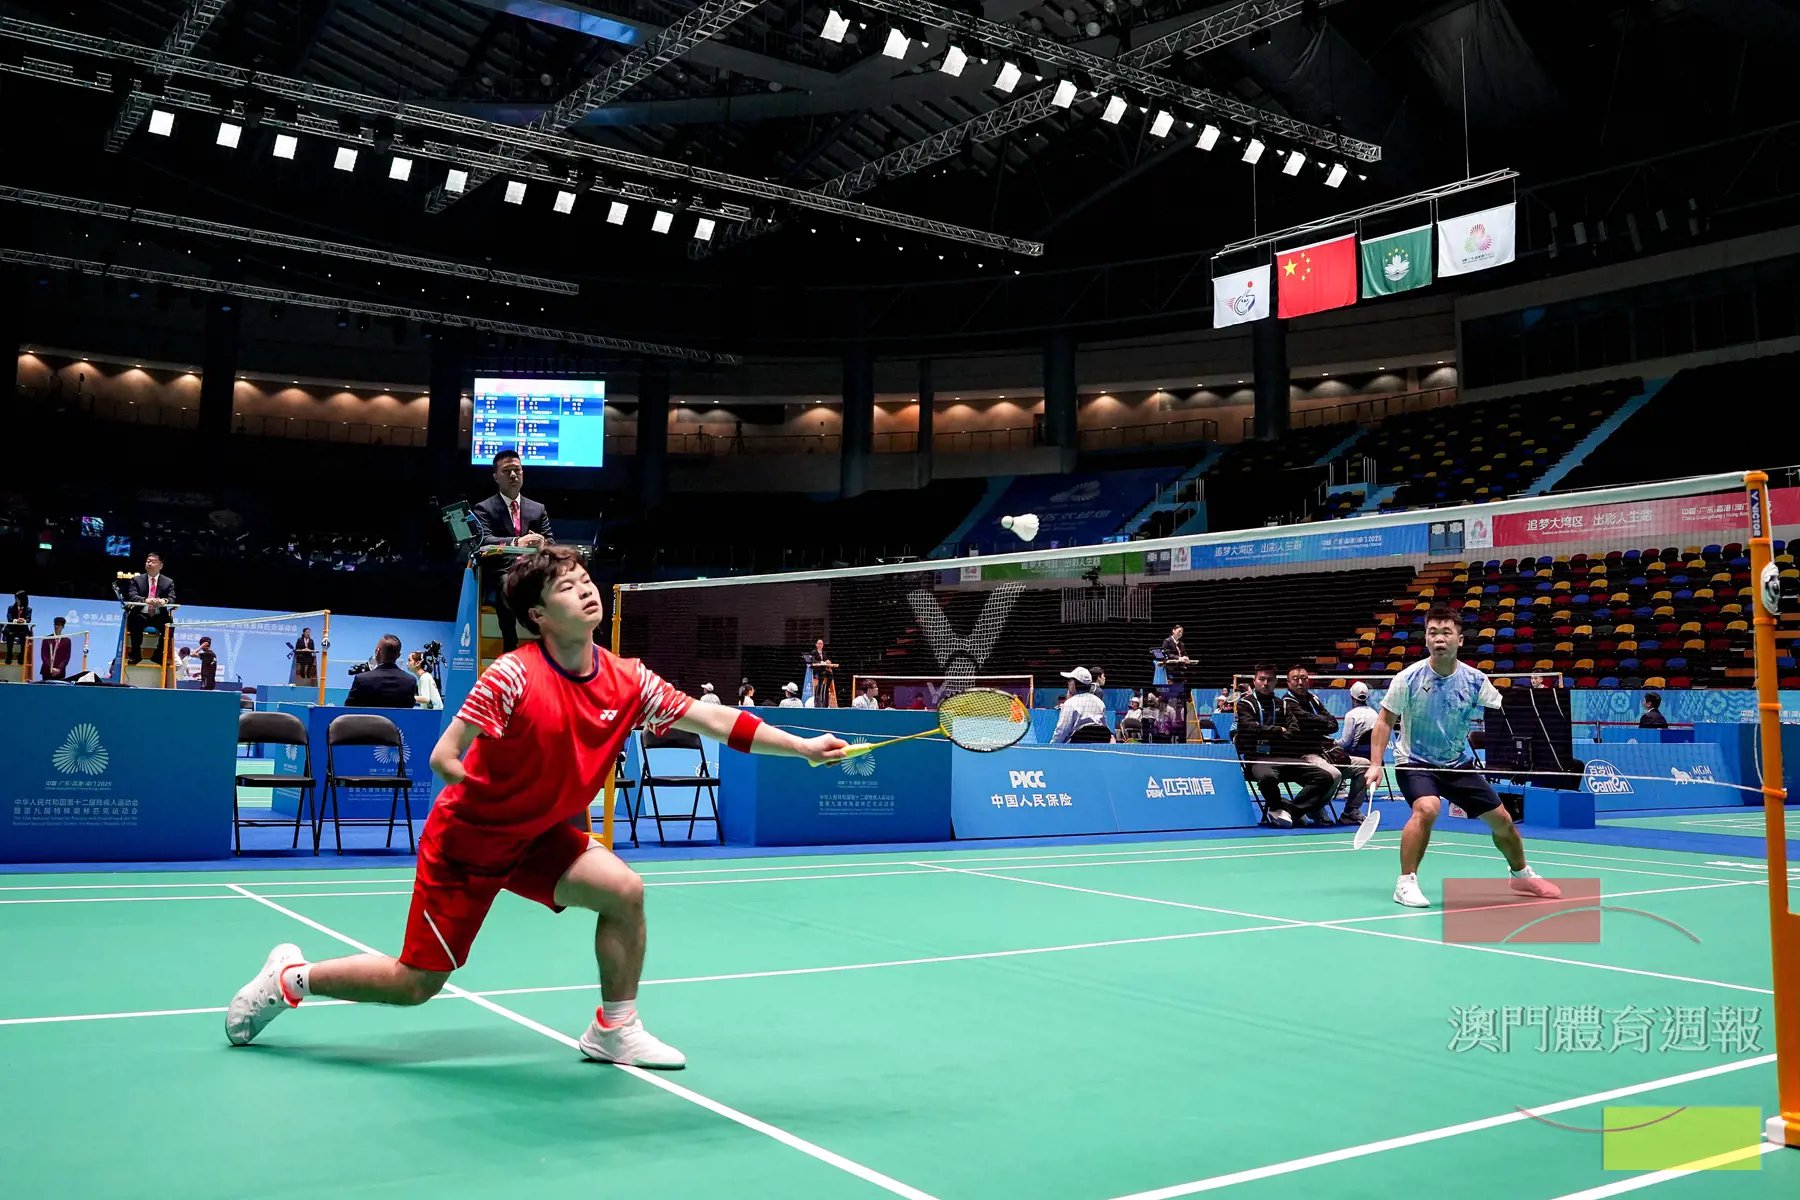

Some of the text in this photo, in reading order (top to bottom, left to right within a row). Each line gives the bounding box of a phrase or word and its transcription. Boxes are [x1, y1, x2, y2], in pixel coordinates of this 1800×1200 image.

[1527, 516, 1583, 532] 追梦大湾区
[1593, 509, 1652, 526] 出彩人生路
[1752, 503, 1761, 536] VICTOR
[1009, 770, 1046, 788] PICC
[1691, 765, 1712, 775] MGM
[1162, 777, 1215, 796] 匹克体育
[991, 793, 1072, 809] 中国人民保险
